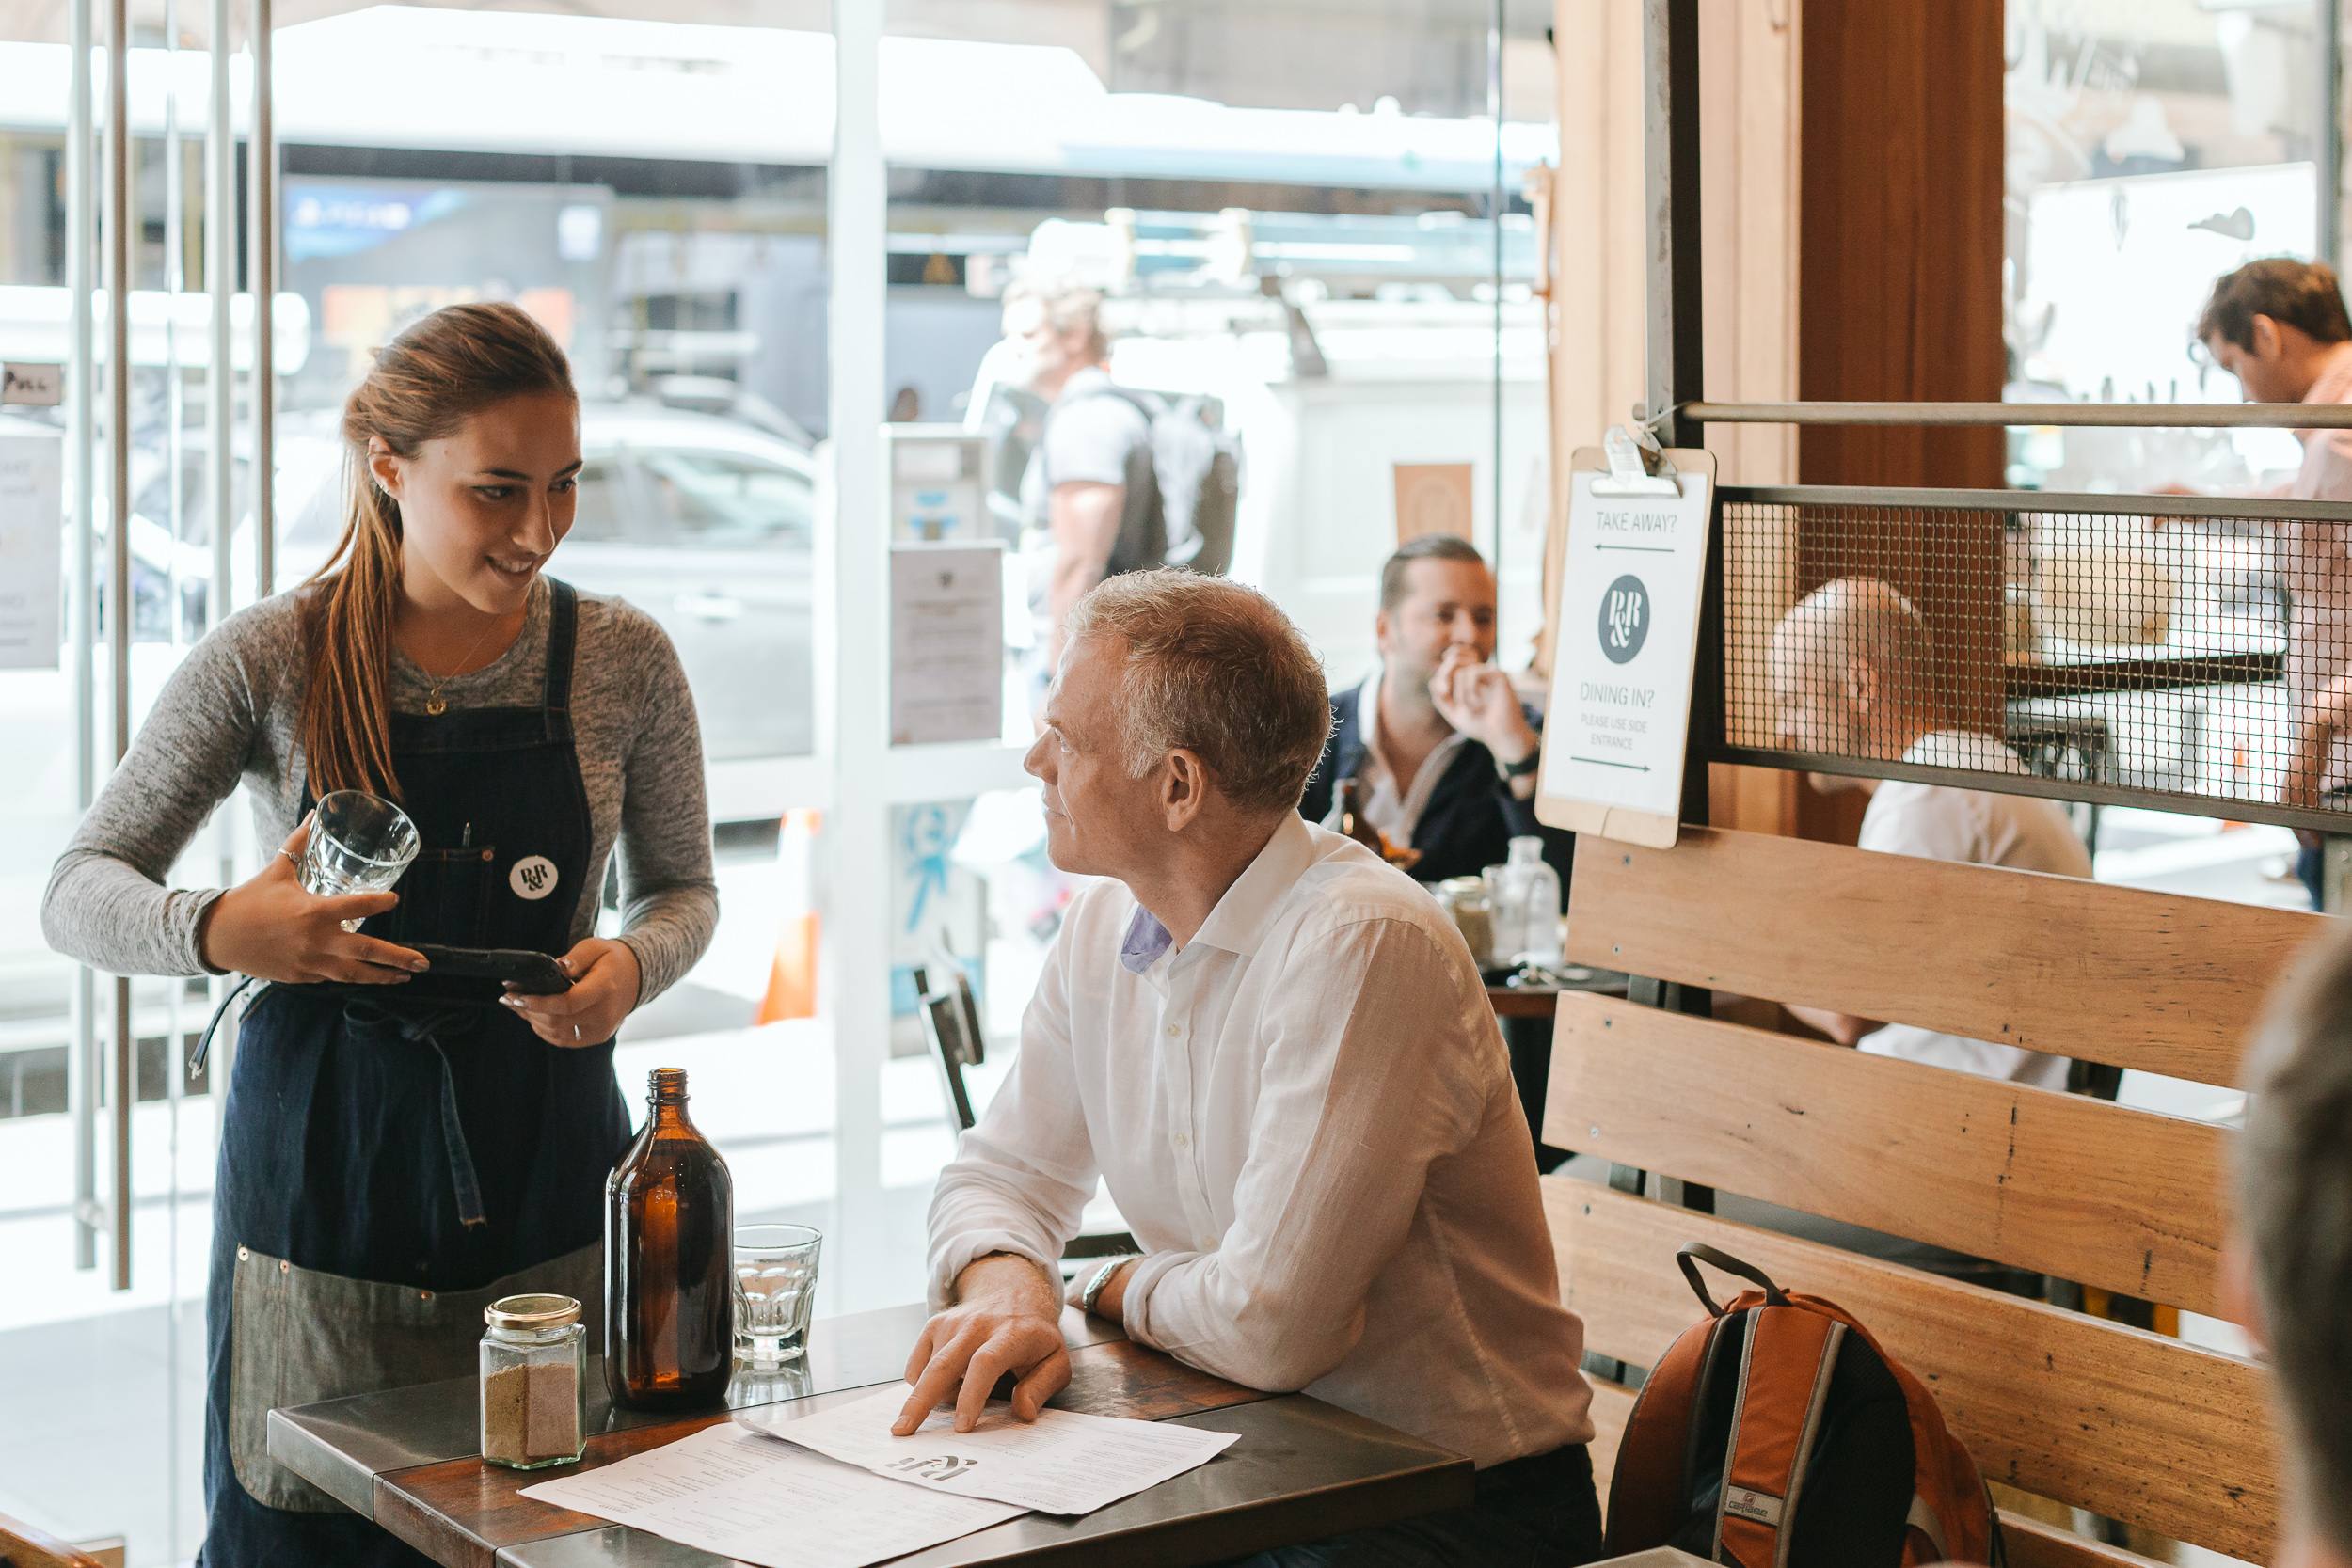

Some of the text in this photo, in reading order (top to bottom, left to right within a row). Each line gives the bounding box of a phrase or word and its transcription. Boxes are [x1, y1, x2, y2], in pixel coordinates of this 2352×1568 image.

[1597, 511, 1677, 534] TAKE AWAY?
[1581, 681, 1655, 709] DINING IN?
[1581, 713, 1647, 734] PLEASE USE SIDE
[1591, 733, 1633, 752] ENTRANCE
